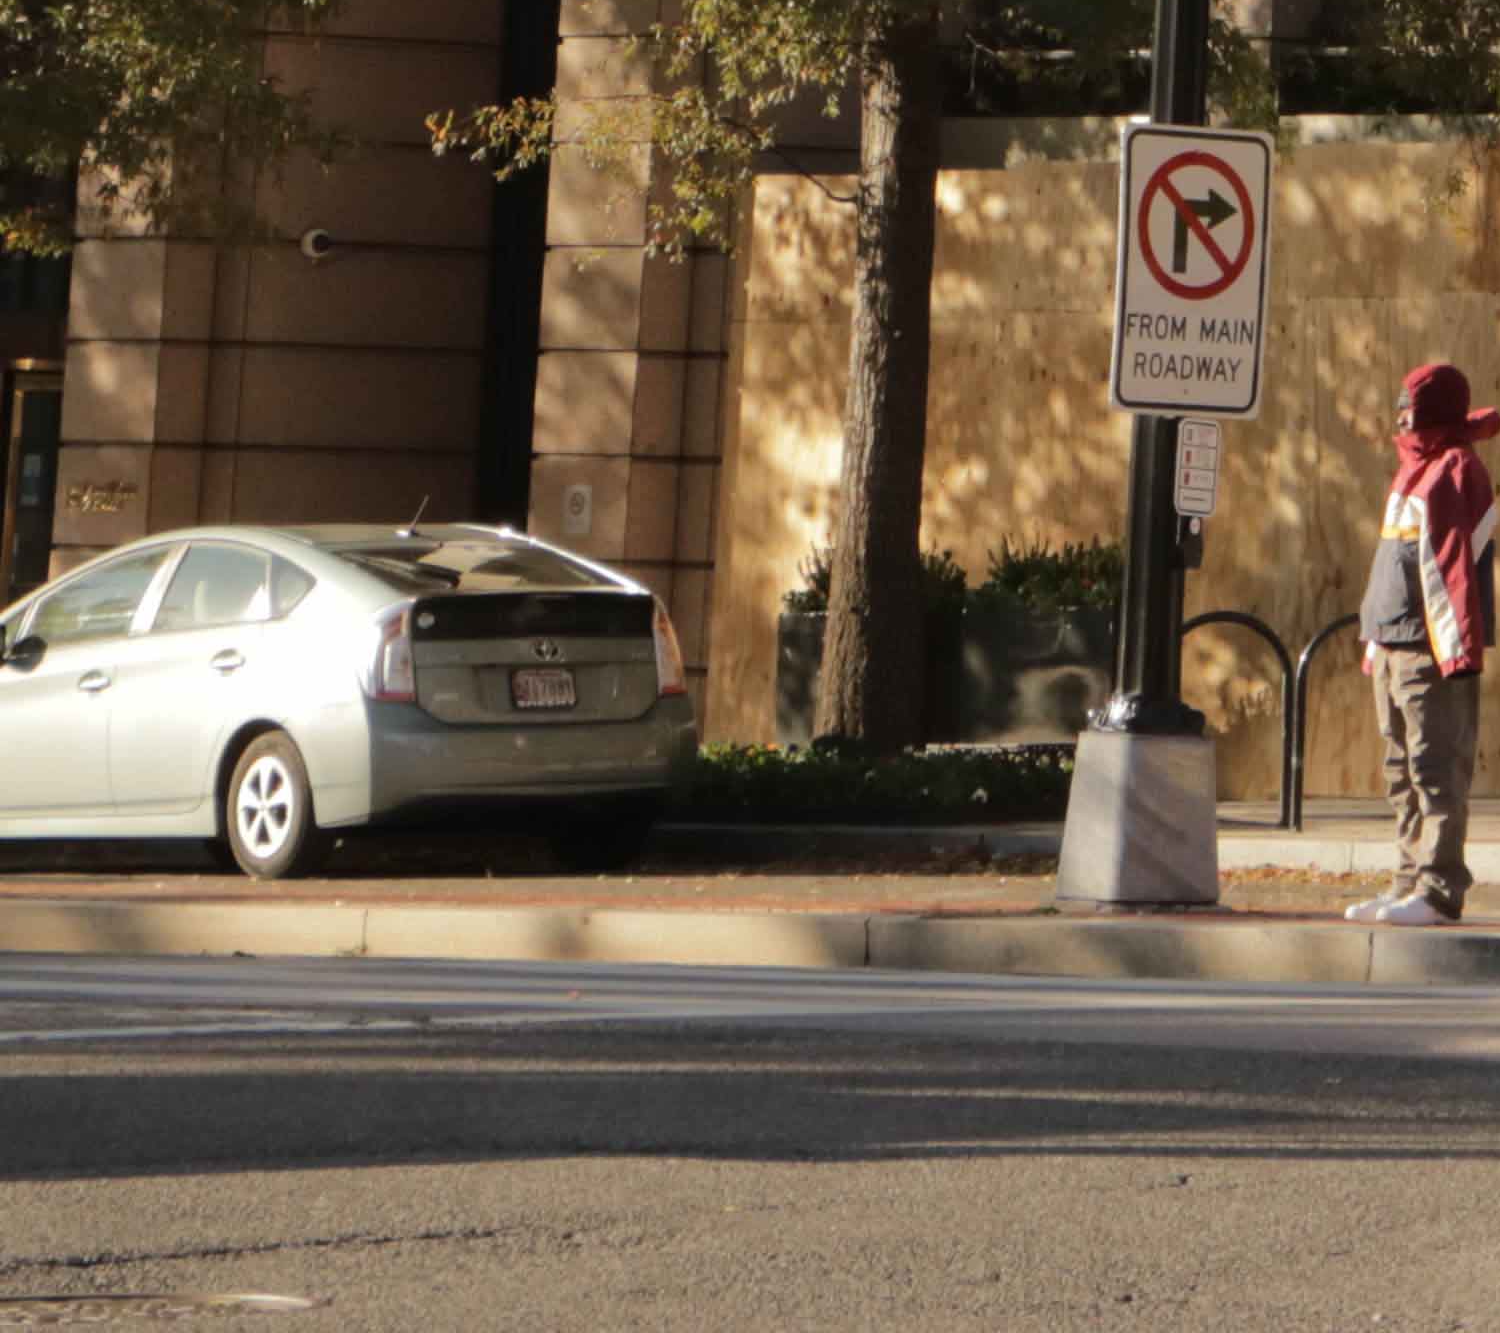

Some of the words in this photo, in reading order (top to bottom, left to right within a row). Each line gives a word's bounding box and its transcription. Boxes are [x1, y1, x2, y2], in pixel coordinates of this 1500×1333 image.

[1126, 313, 1187, 343] FROM
[1200, 318, 1255, 346] MAIN
[1133, 352, 1241, 382] ROADWAY
